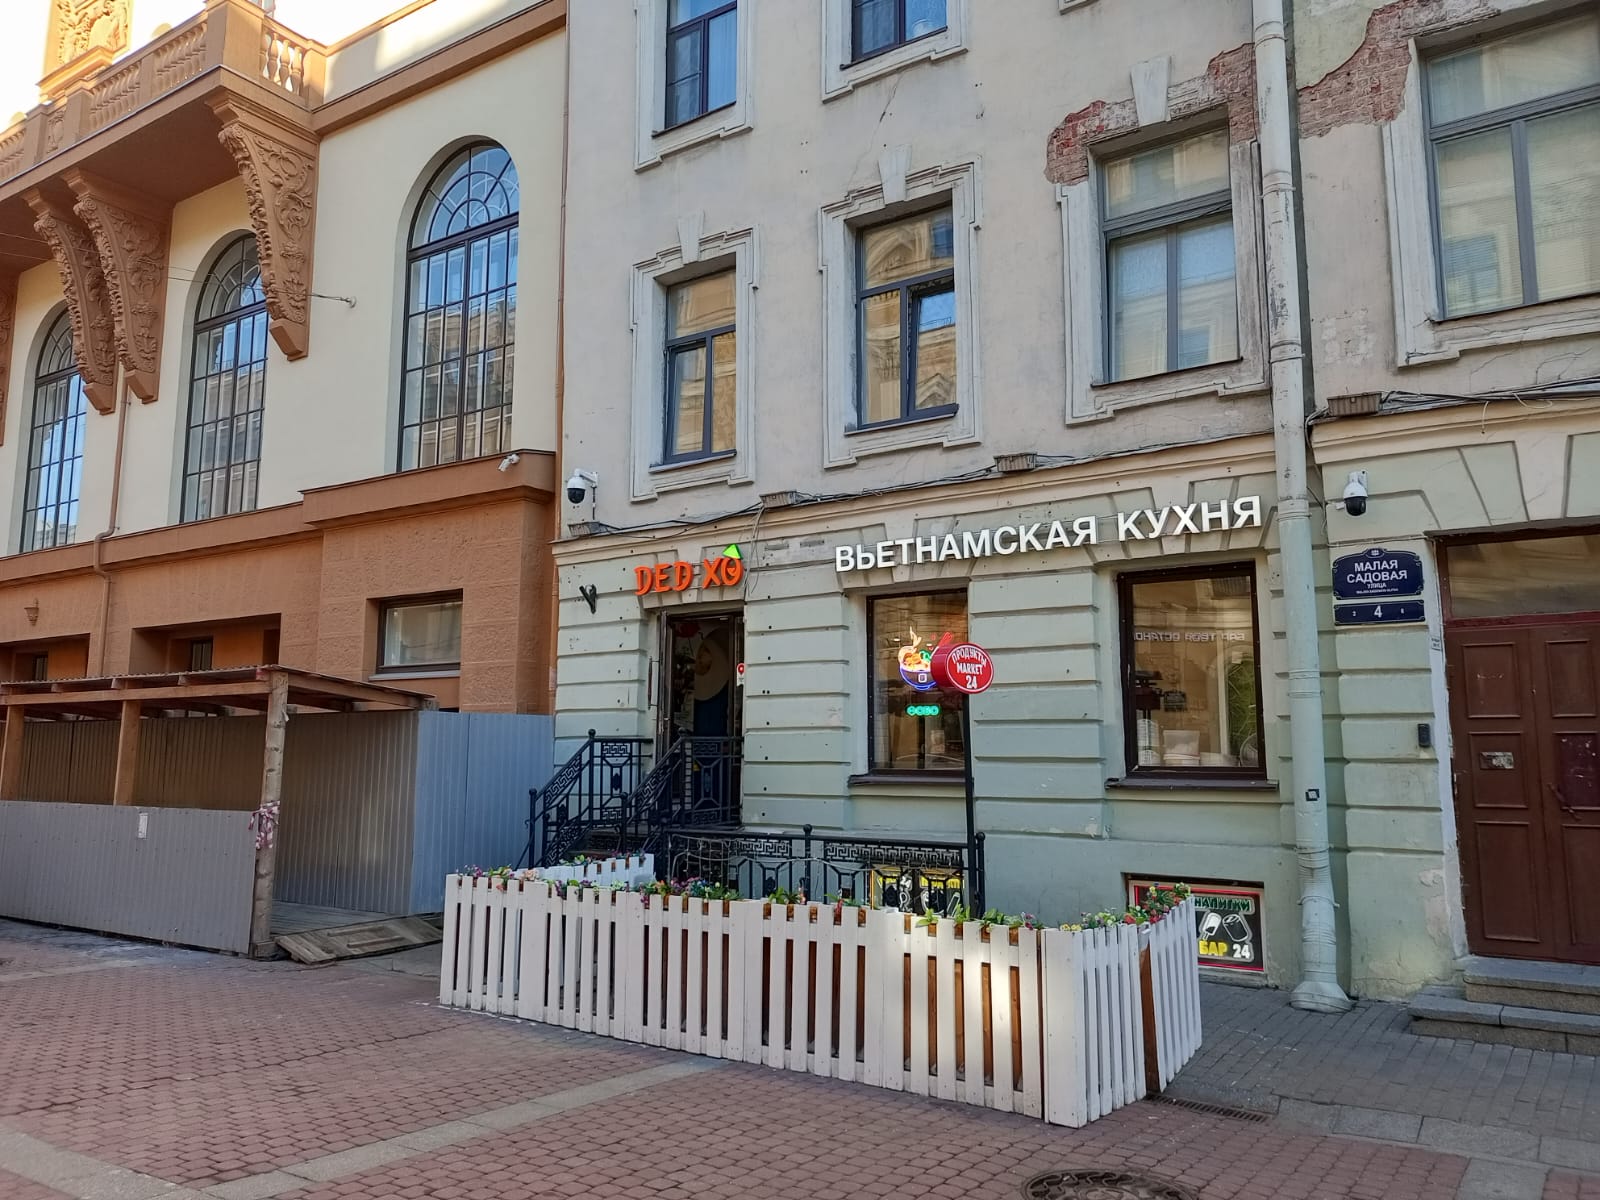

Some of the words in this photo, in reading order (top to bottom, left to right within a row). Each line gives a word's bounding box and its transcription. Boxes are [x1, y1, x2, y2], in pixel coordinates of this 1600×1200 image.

[835, 515, 1098, 572] ВЬЕТНАМСКАЯ
[1117, 495, 1262, 541] КУХНЯ
[1354, 559, 1399, 573] МАЛАЯ
[634, 560, 693, 596] DED
[1346, 570, 1408, 585] САДОВАЯ
[1374, 605, 1383, 618] 4
[951, 647, 987, 667] ПРОДУКТЫ
[956, 661, 983, 675] MARKET
[965, 675, 978, 689] 24
[1194, 896, 1251, 912] НАПИТКИ
[1199, 940, 1228, 956] БАР
[1233, 943, 1251, 959] 24
